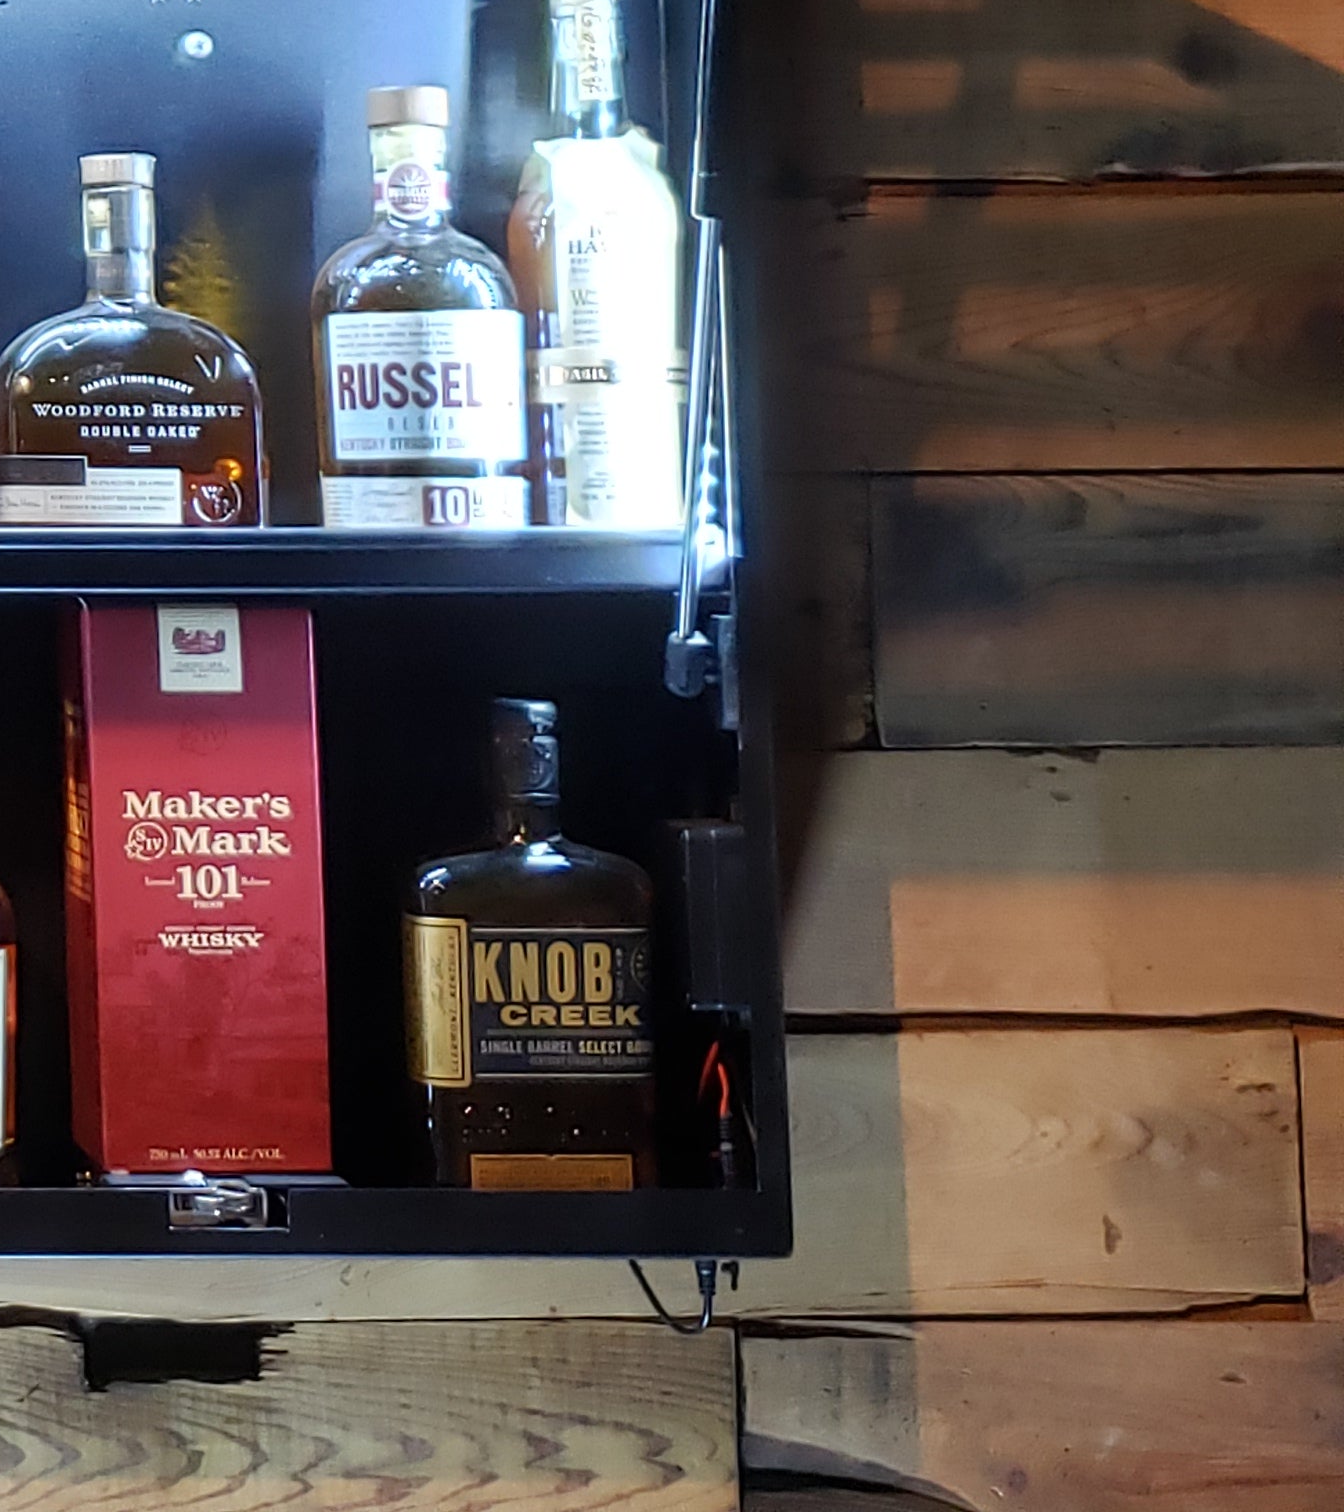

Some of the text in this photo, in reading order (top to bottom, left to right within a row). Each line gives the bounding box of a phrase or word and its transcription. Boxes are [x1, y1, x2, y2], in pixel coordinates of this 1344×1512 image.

[32, 403, 242, 418] WOODFORD RESERVE
[80, 425, 198, 437] DOUBLE OAKED
[429, 487, 467, 525] 10
[122, 790, 292, 820] Maker's
[171, 826, 292, 856] Mark
[176, 864, 243, 899] 101
[158, 933, 265, 948] WHISKY
[473, 941, 613, 1004] KNOB
[500, 1005, 641, 1027] CREEK
[480, 1039, 621, 1054] SINGLE BARREL SELECT
